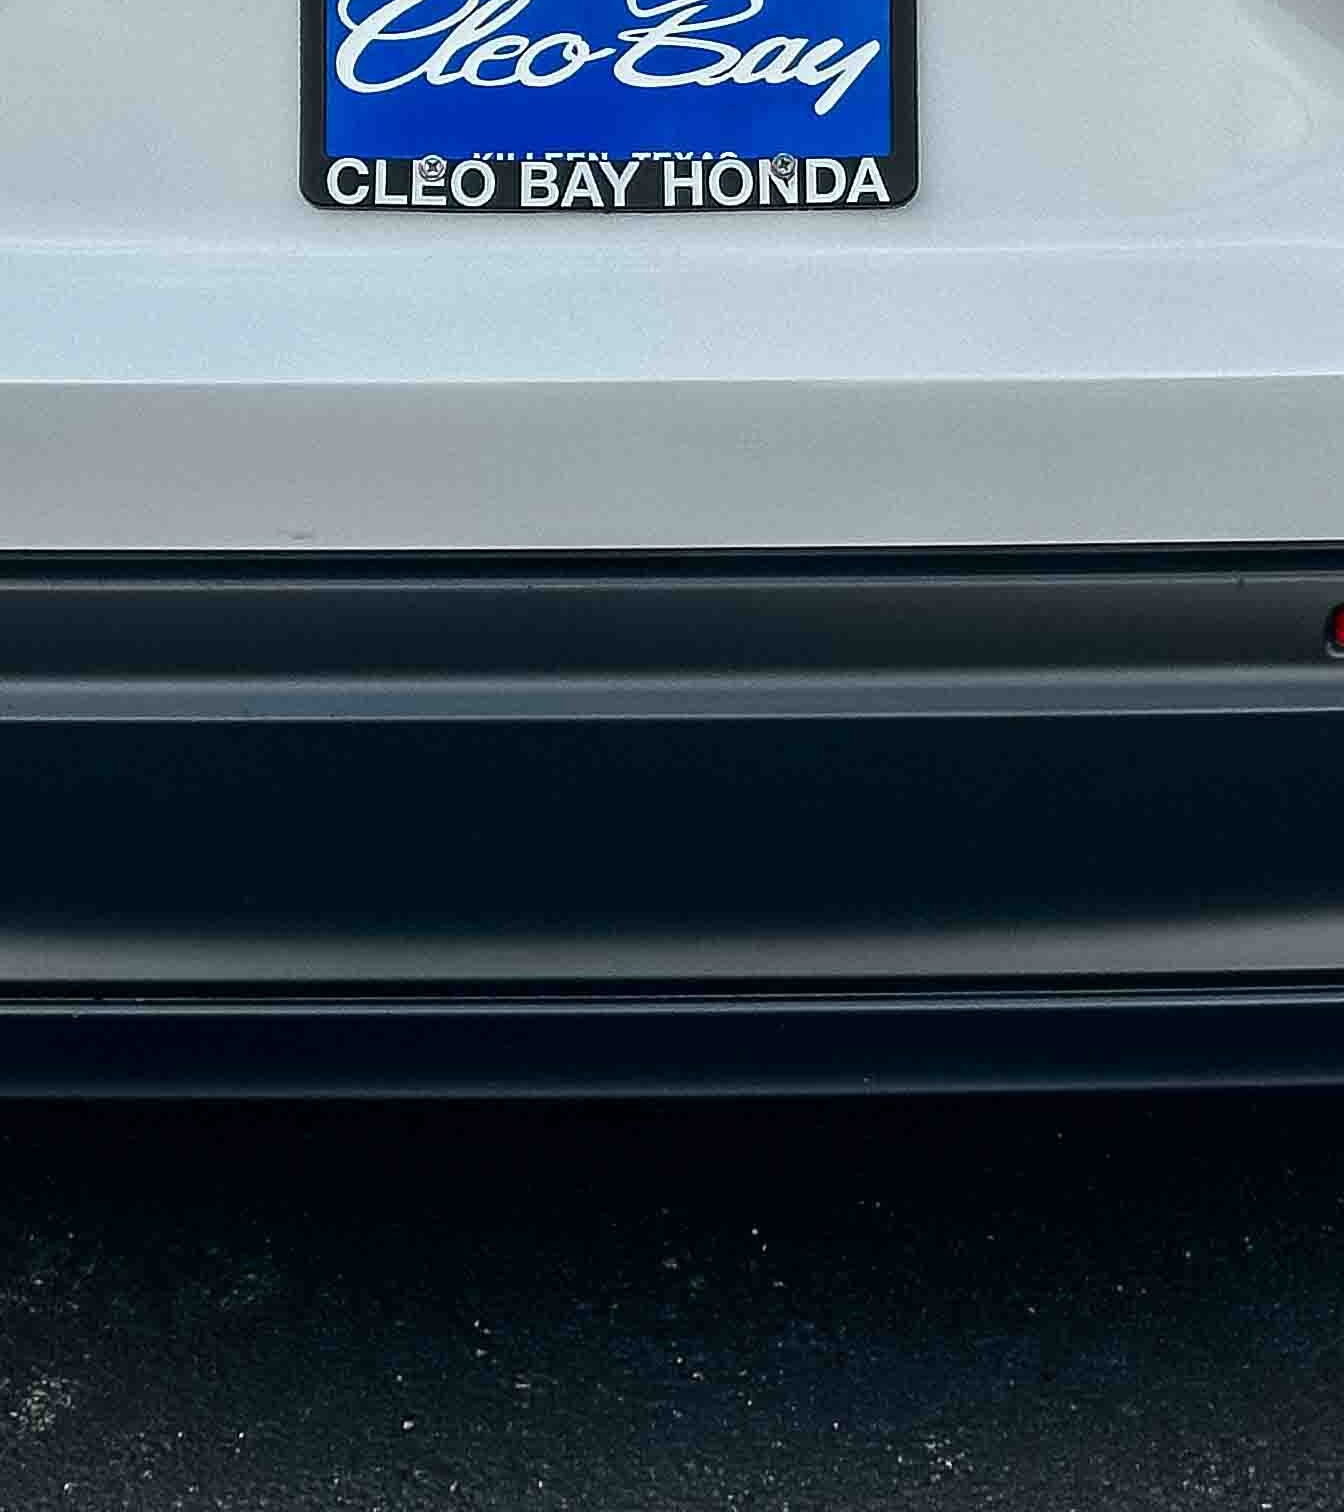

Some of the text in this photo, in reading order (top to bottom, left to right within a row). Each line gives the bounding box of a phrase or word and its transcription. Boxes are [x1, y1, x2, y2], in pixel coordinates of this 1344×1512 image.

[326, 157, 891, 208] CLEO BAY HONDA
